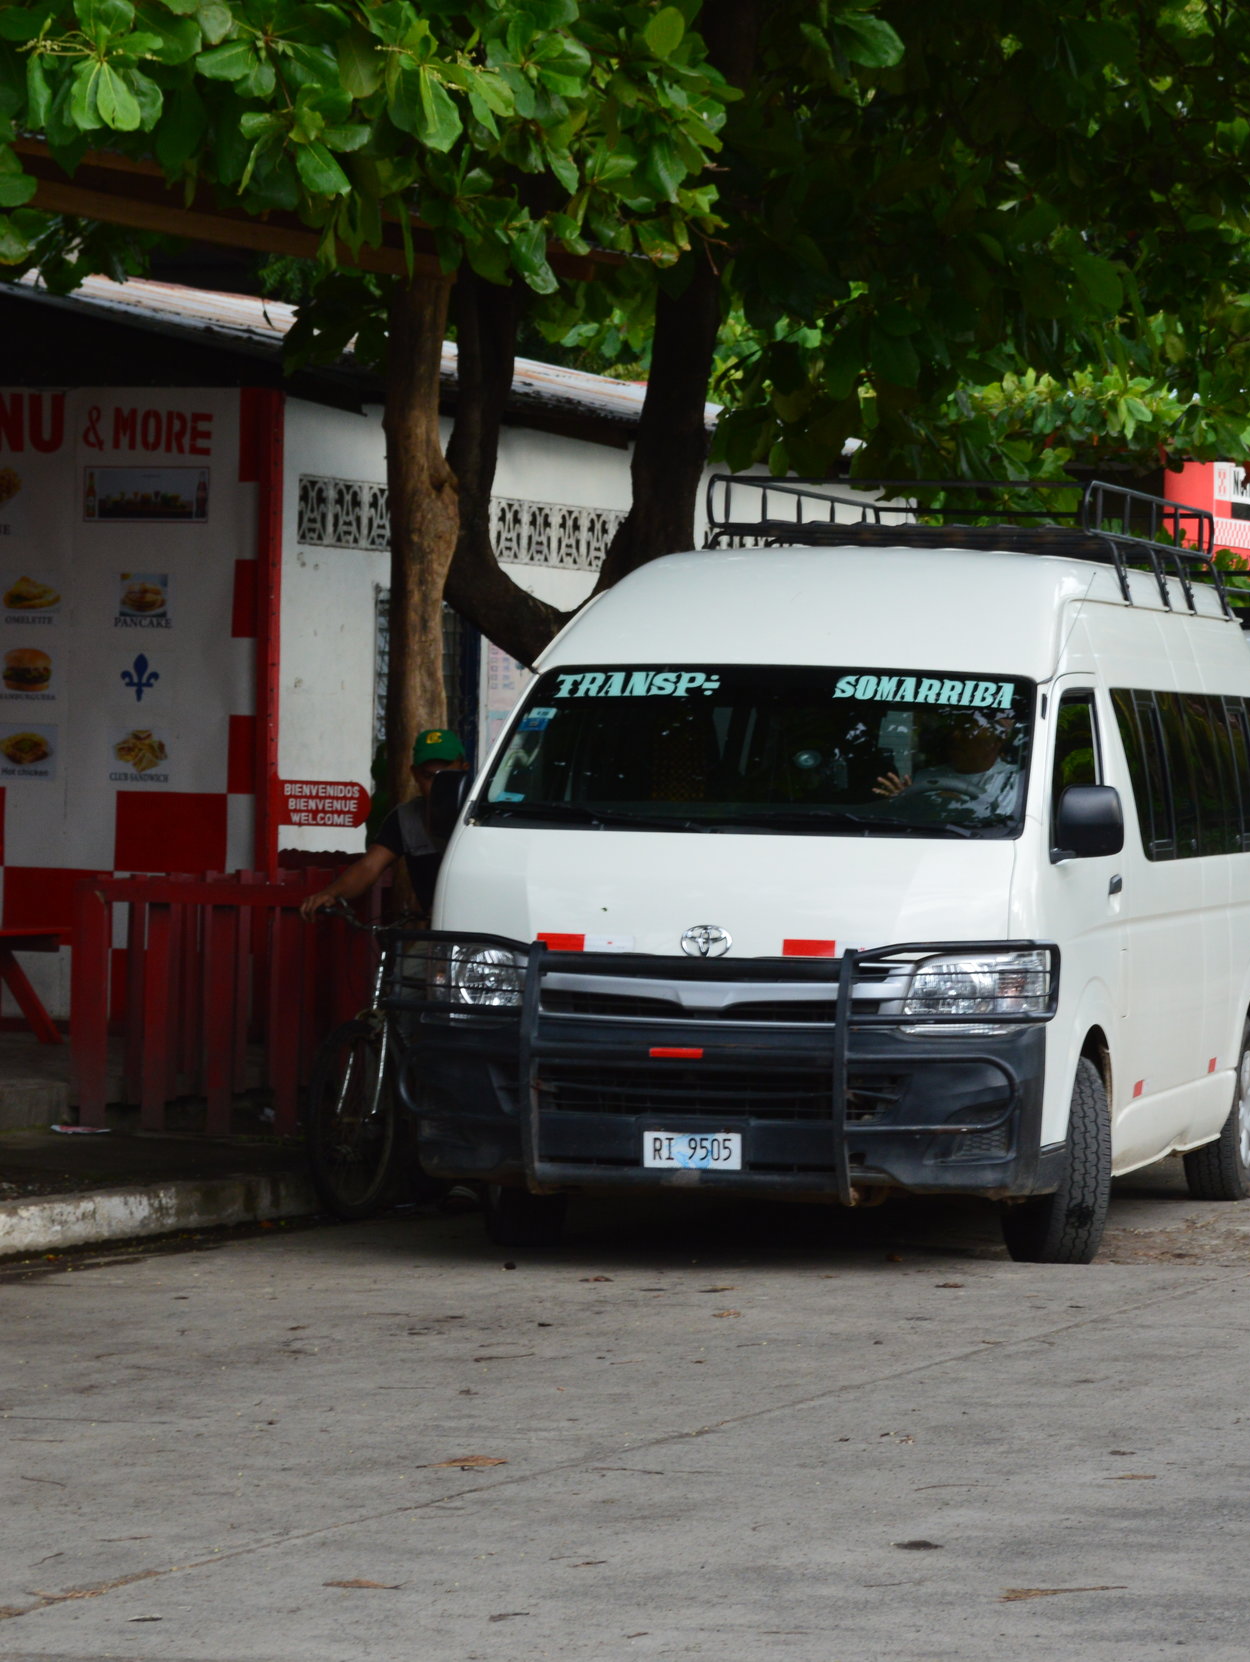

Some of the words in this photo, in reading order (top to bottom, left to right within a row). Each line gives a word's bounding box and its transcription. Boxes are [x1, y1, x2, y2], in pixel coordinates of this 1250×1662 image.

[83, 405, 104, 451] &
[113, 407, 213, 456] MORE
[114, 617, 171, 629] PANCAKE
[832, 675, 1015, 709] SOMARRIBA
[284, 783, 360, 798] BIENVENIDOS
[288, 798, 358, 811] BIENVENUE
[291, 812, 354, 826] WELCOME
[653, 1137, 675, 1161] RI
[688, 1137, 732, 1162] 9505
